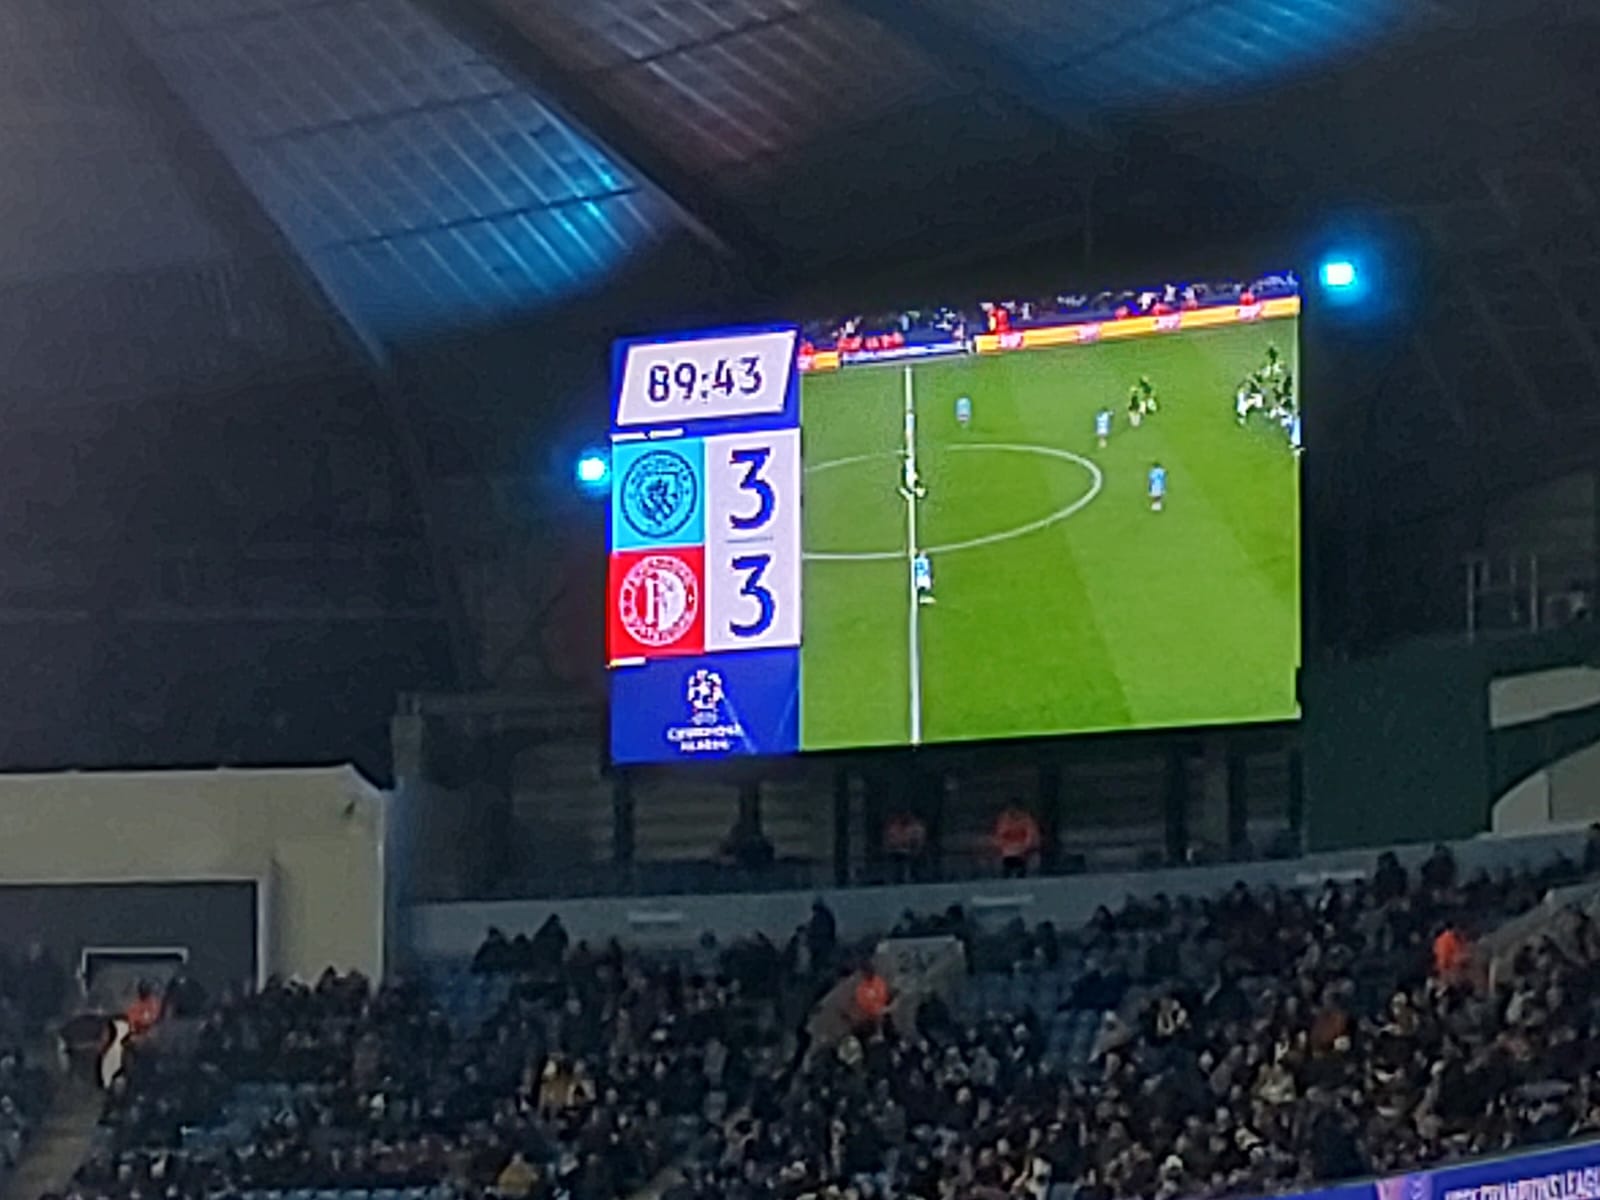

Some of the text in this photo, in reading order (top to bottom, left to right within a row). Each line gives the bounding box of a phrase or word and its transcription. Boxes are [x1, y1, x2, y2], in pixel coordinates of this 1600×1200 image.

[648, 357, 763, 402] 89:43
[728, 447, 776, 530] 3
[729, 553, 776, 638] 3
